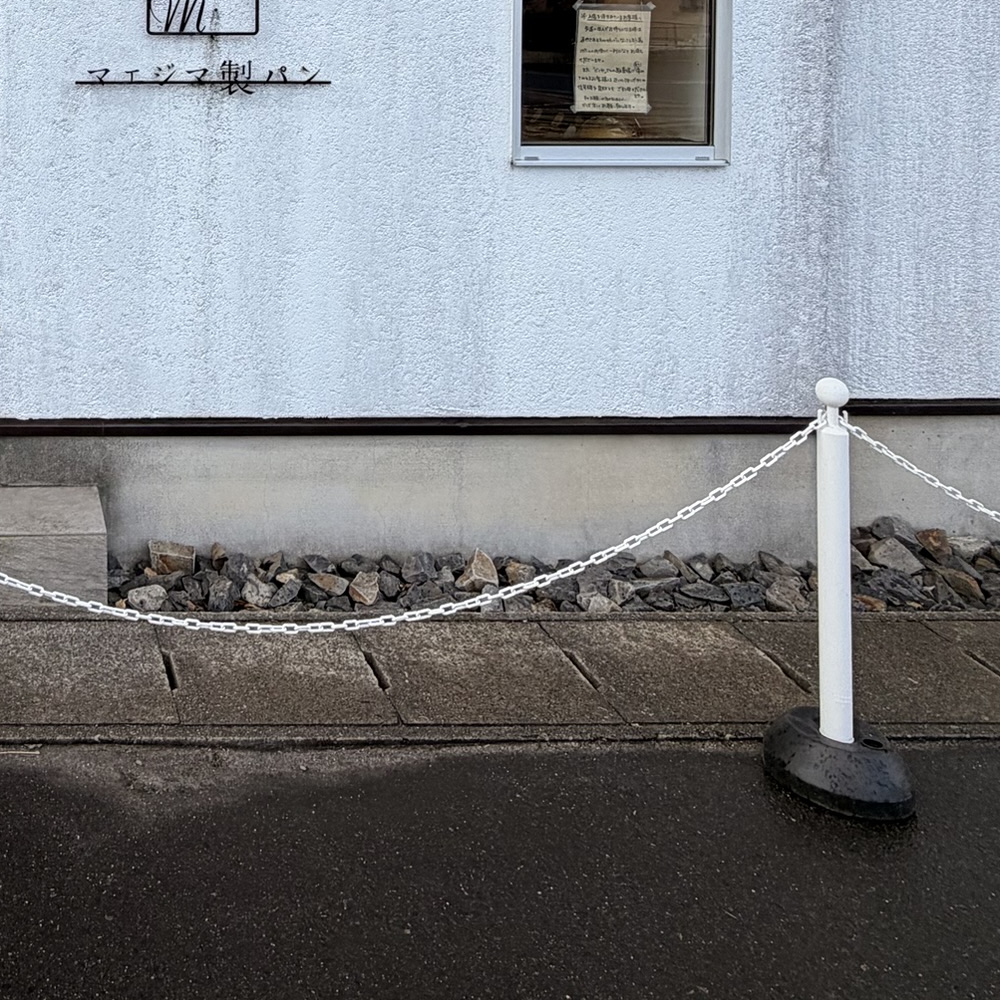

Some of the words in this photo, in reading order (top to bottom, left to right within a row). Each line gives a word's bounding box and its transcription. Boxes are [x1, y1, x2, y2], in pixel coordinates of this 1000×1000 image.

[87, 60, 321, 96] マエジマ製パン
